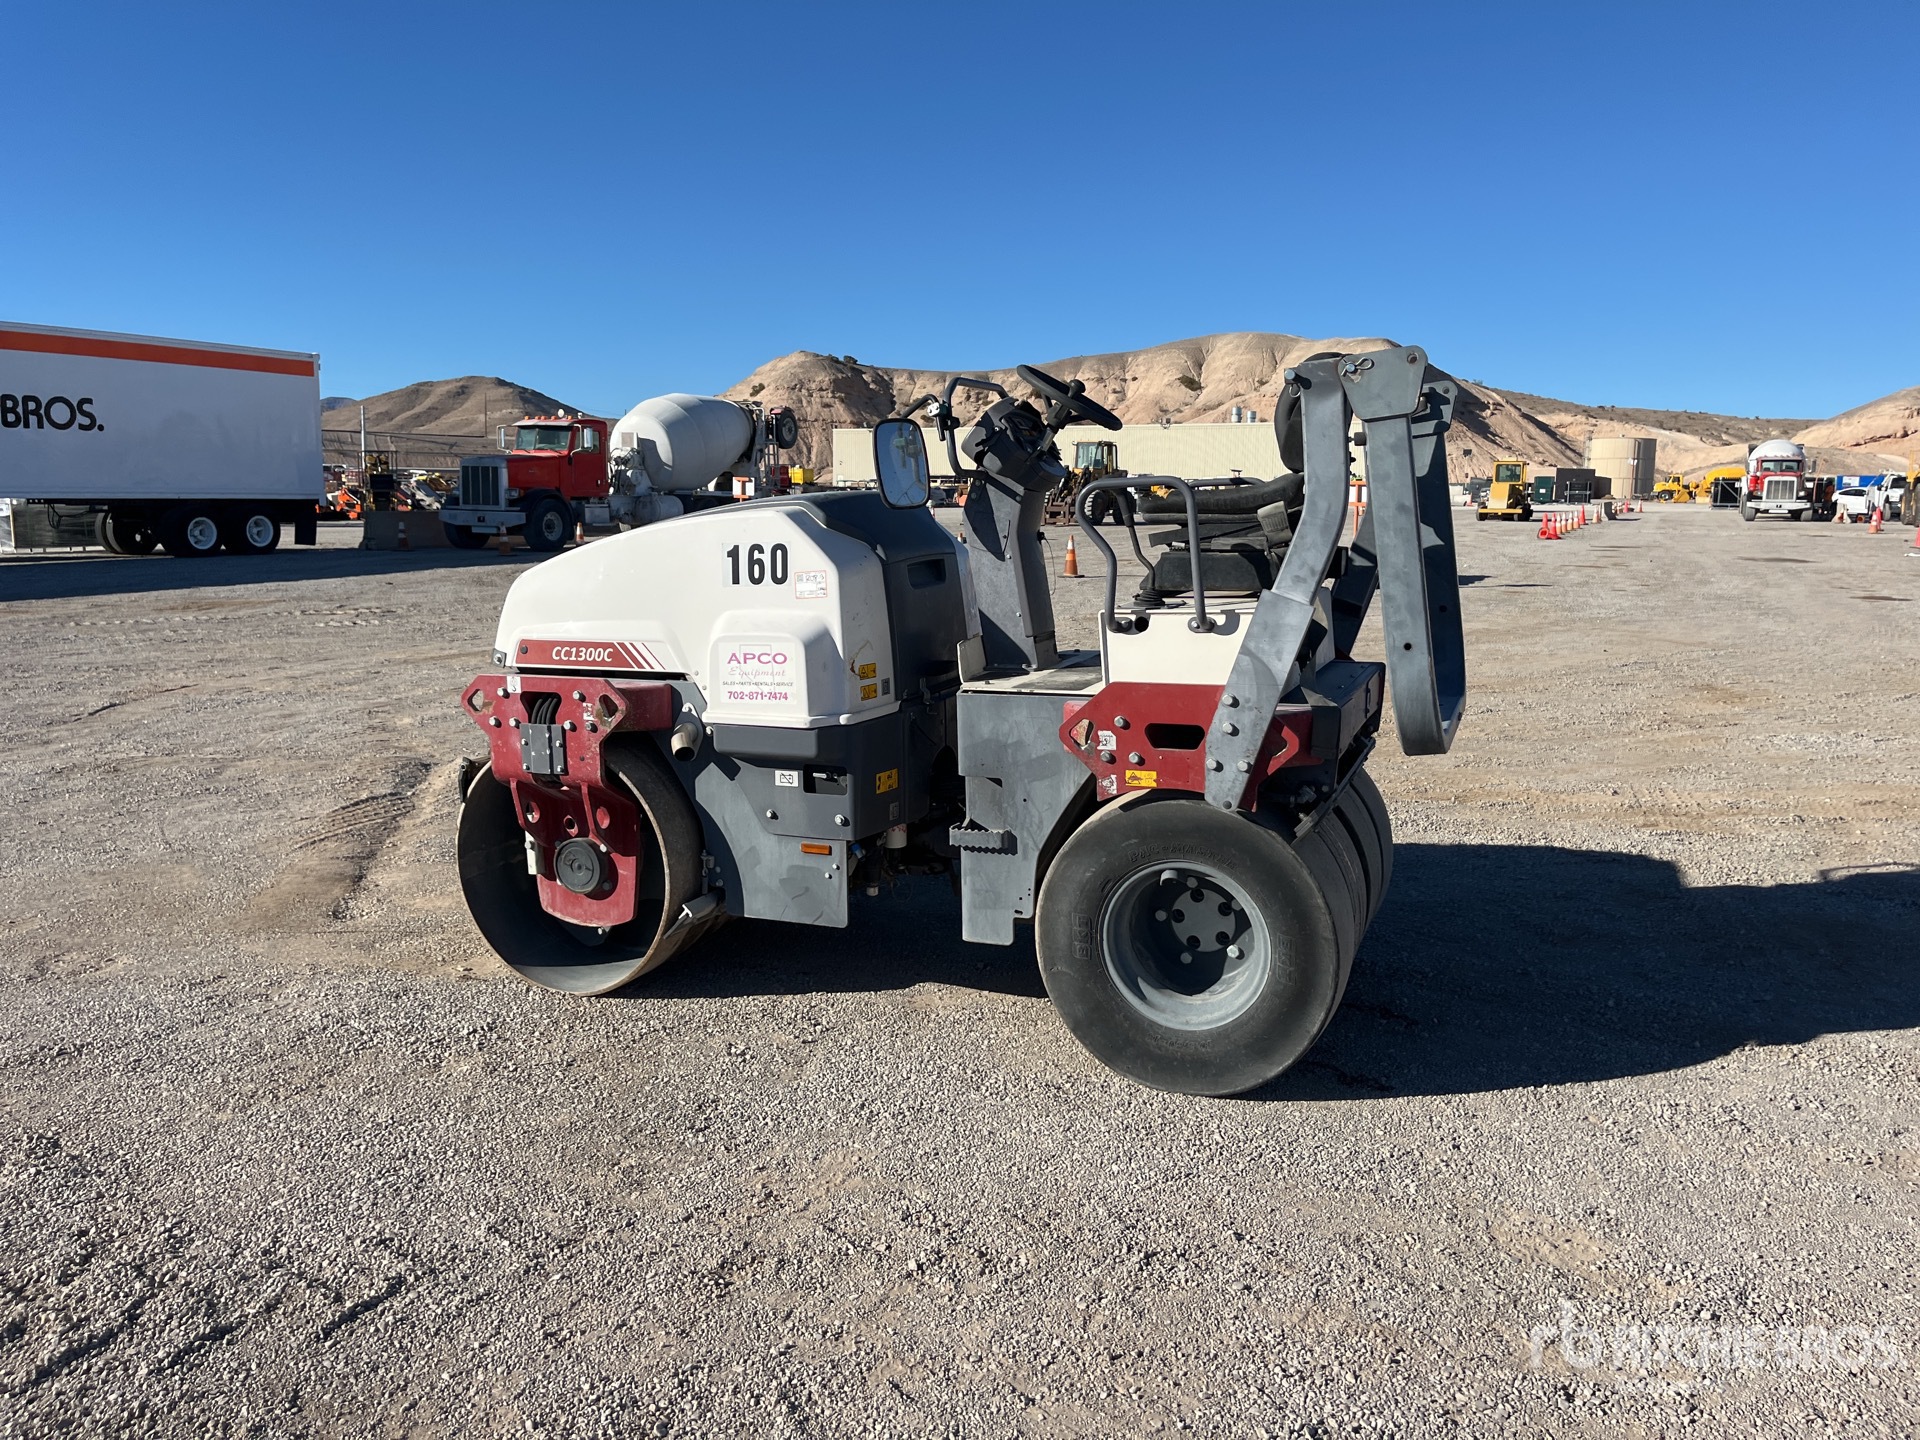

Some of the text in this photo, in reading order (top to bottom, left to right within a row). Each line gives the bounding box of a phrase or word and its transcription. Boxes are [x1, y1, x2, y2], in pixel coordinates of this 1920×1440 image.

[0, 393, 105, 432] BROS.
[726, 543, 789, 586] 160
[551, 646, 614, 662] CC1300C
[727, 652, 788, 665] APCO
[728, 666, 786, 680] Equipment
[727, 690, 789, 701] 702-871-7474
